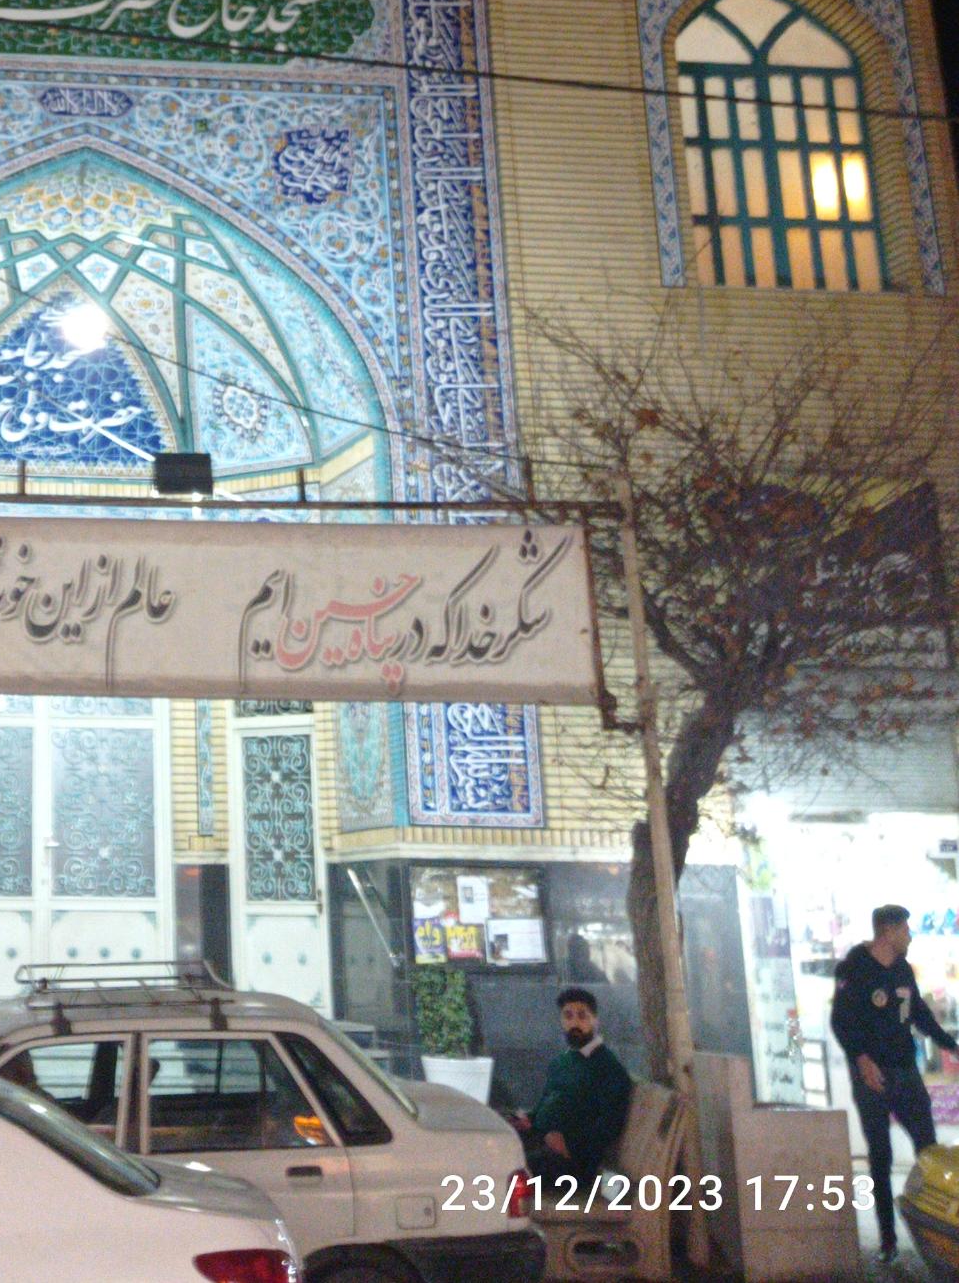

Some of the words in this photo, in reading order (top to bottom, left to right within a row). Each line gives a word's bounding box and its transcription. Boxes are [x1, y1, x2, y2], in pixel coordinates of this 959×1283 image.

[25, 557, 88, 640] این
[83, 554, 123, 619] از
[106, 555, 176, 687] عالم
[424, 545, 496, 661] که
[491, 529, 568, 660] شکر
[387, 617, 425, 657] در
[451, 604, 498, 661] خدا
